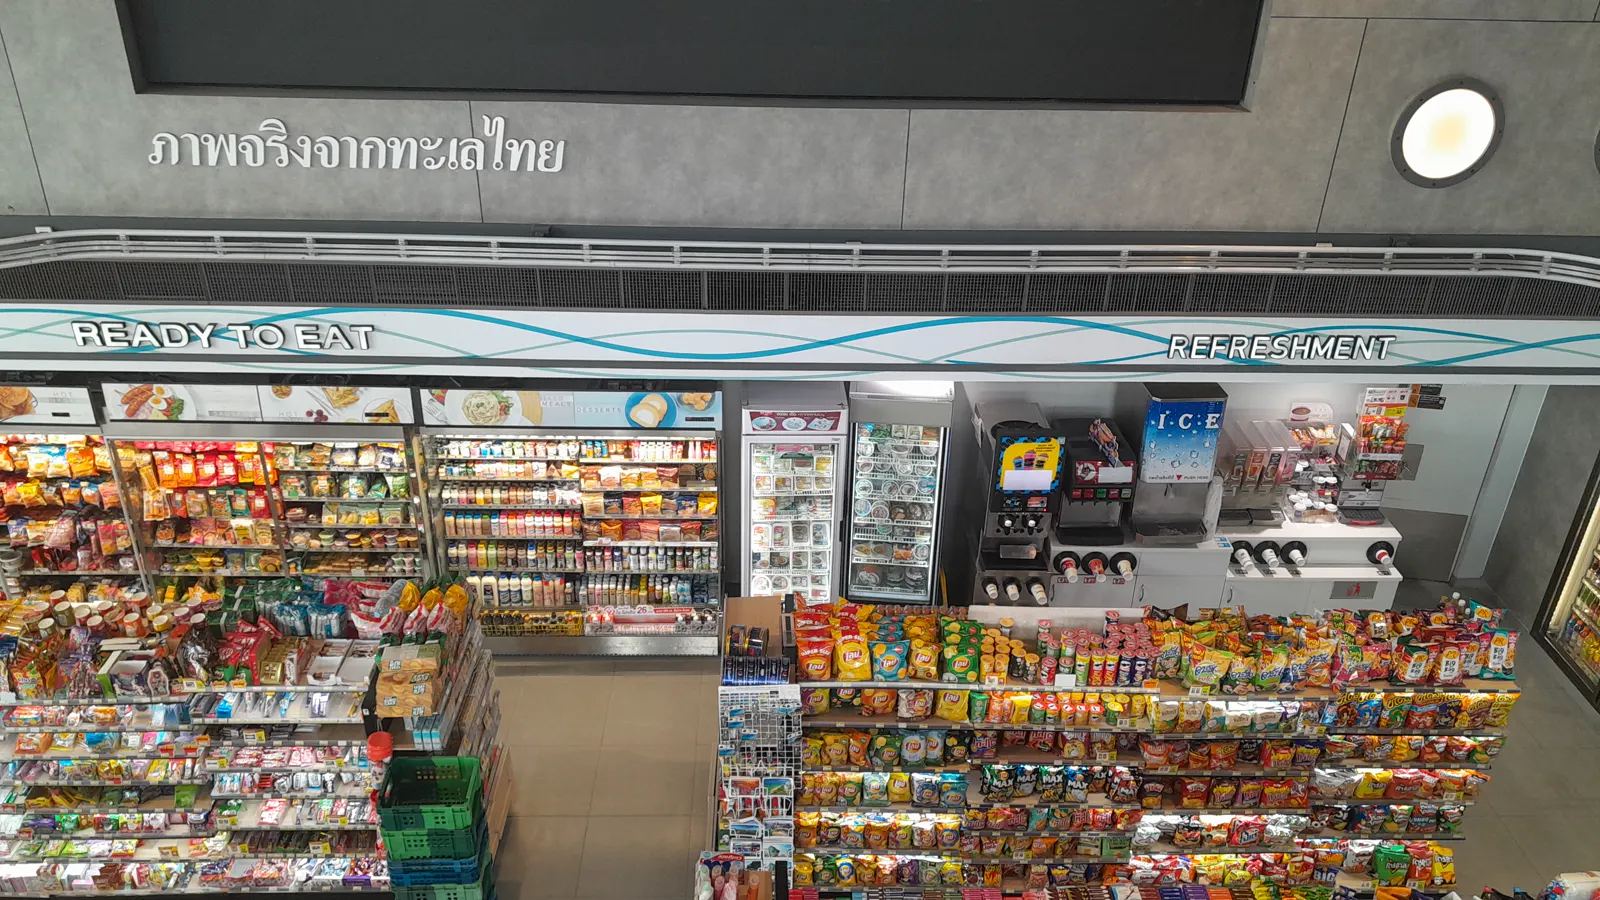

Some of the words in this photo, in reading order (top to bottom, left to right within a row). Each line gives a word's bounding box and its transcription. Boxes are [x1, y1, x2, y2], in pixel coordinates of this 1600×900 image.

[147, 114, 566, 173] ภาพจริงจากทะเลไทย
[71, 321, 215, 348] READY
[227, 323, 285, 350] TO
[295, 324, 374, 351] EAT
[1167, 334, 1397, 361] REFRESHMENT
[836, 635, 853, 645] SUPER
[853, 634, 865, 642] SIZE
[801, 649, 818, 657] SUPER
[993, 778, 1014, 787] MAX
[1016, 774, 1036, 783] MAX
[1043, 774, 1063, 784] MAX
[1067, 779, 1089, 789] MAX
[1313, 870, 1335, 882] BIG
